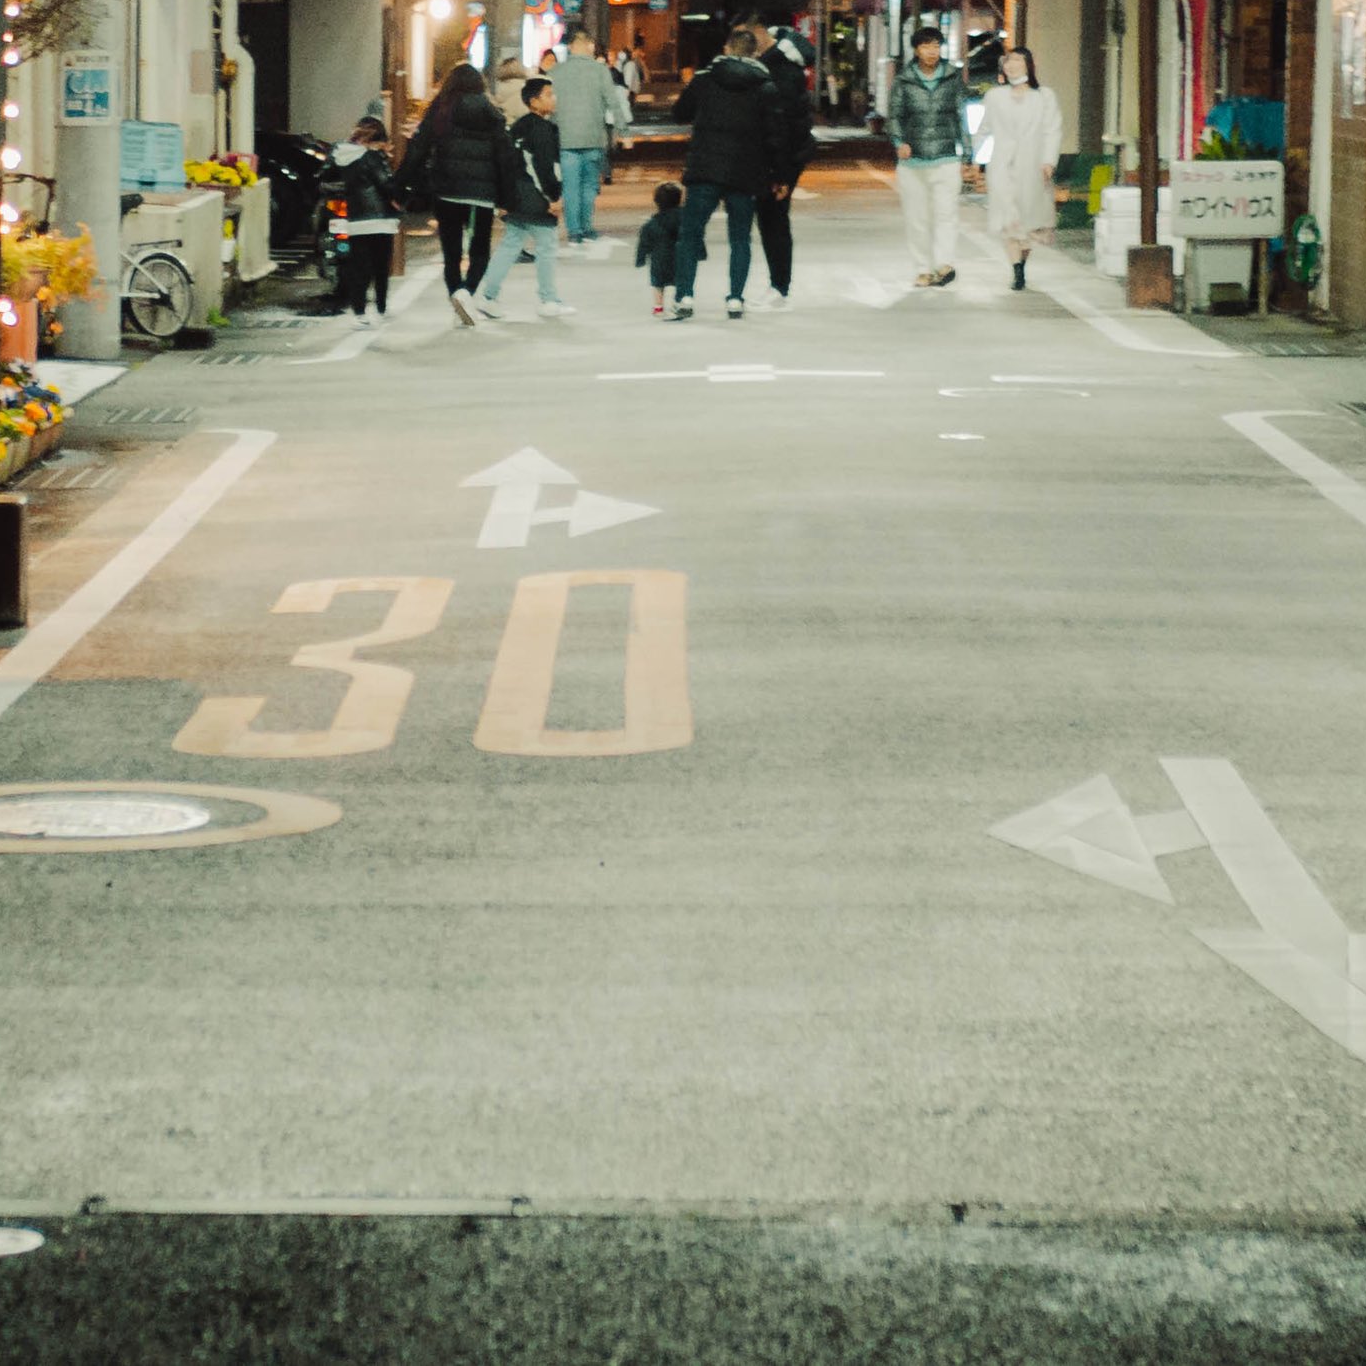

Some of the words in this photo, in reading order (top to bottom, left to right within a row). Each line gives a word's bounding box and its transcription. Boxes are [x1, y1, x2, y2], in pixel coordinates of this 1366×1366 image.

[1179, 196, 1276, 219] ホワイトハウス
[172, 569, 694, 758] 30
